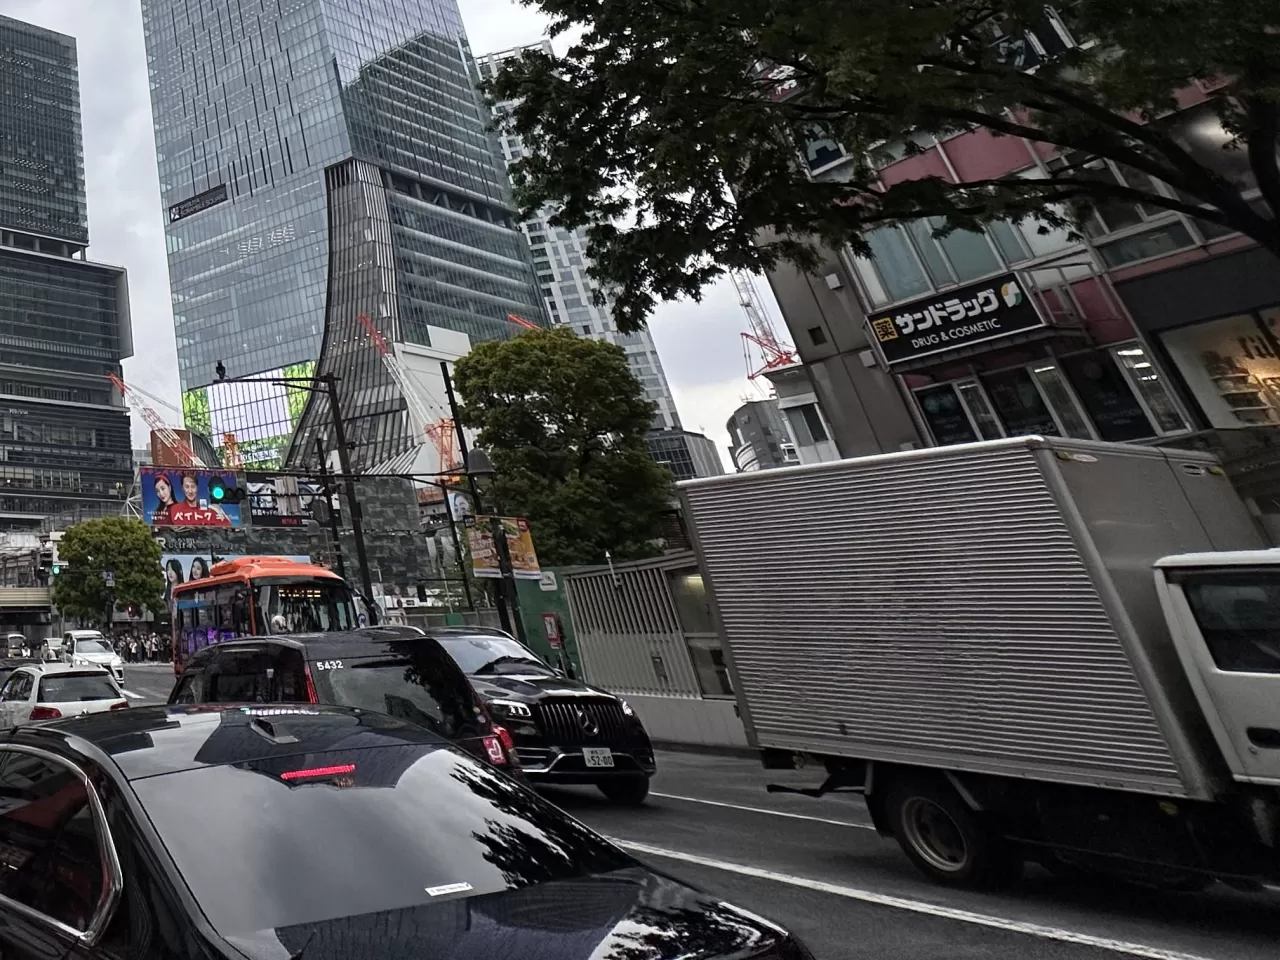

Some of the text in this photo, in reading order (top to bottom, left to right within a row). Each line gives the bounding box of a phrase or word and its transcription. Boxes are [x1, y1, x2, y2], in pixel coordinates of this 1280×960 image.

[895, 288, 999, 334] サンドラッグ
[875, 318, 897, 340] 薬
[911, 318, 1001, 349] DRUG & COSMETIC
[317, 660, 344, 671] 5432
[591, 756, 613, 766] 52-00
